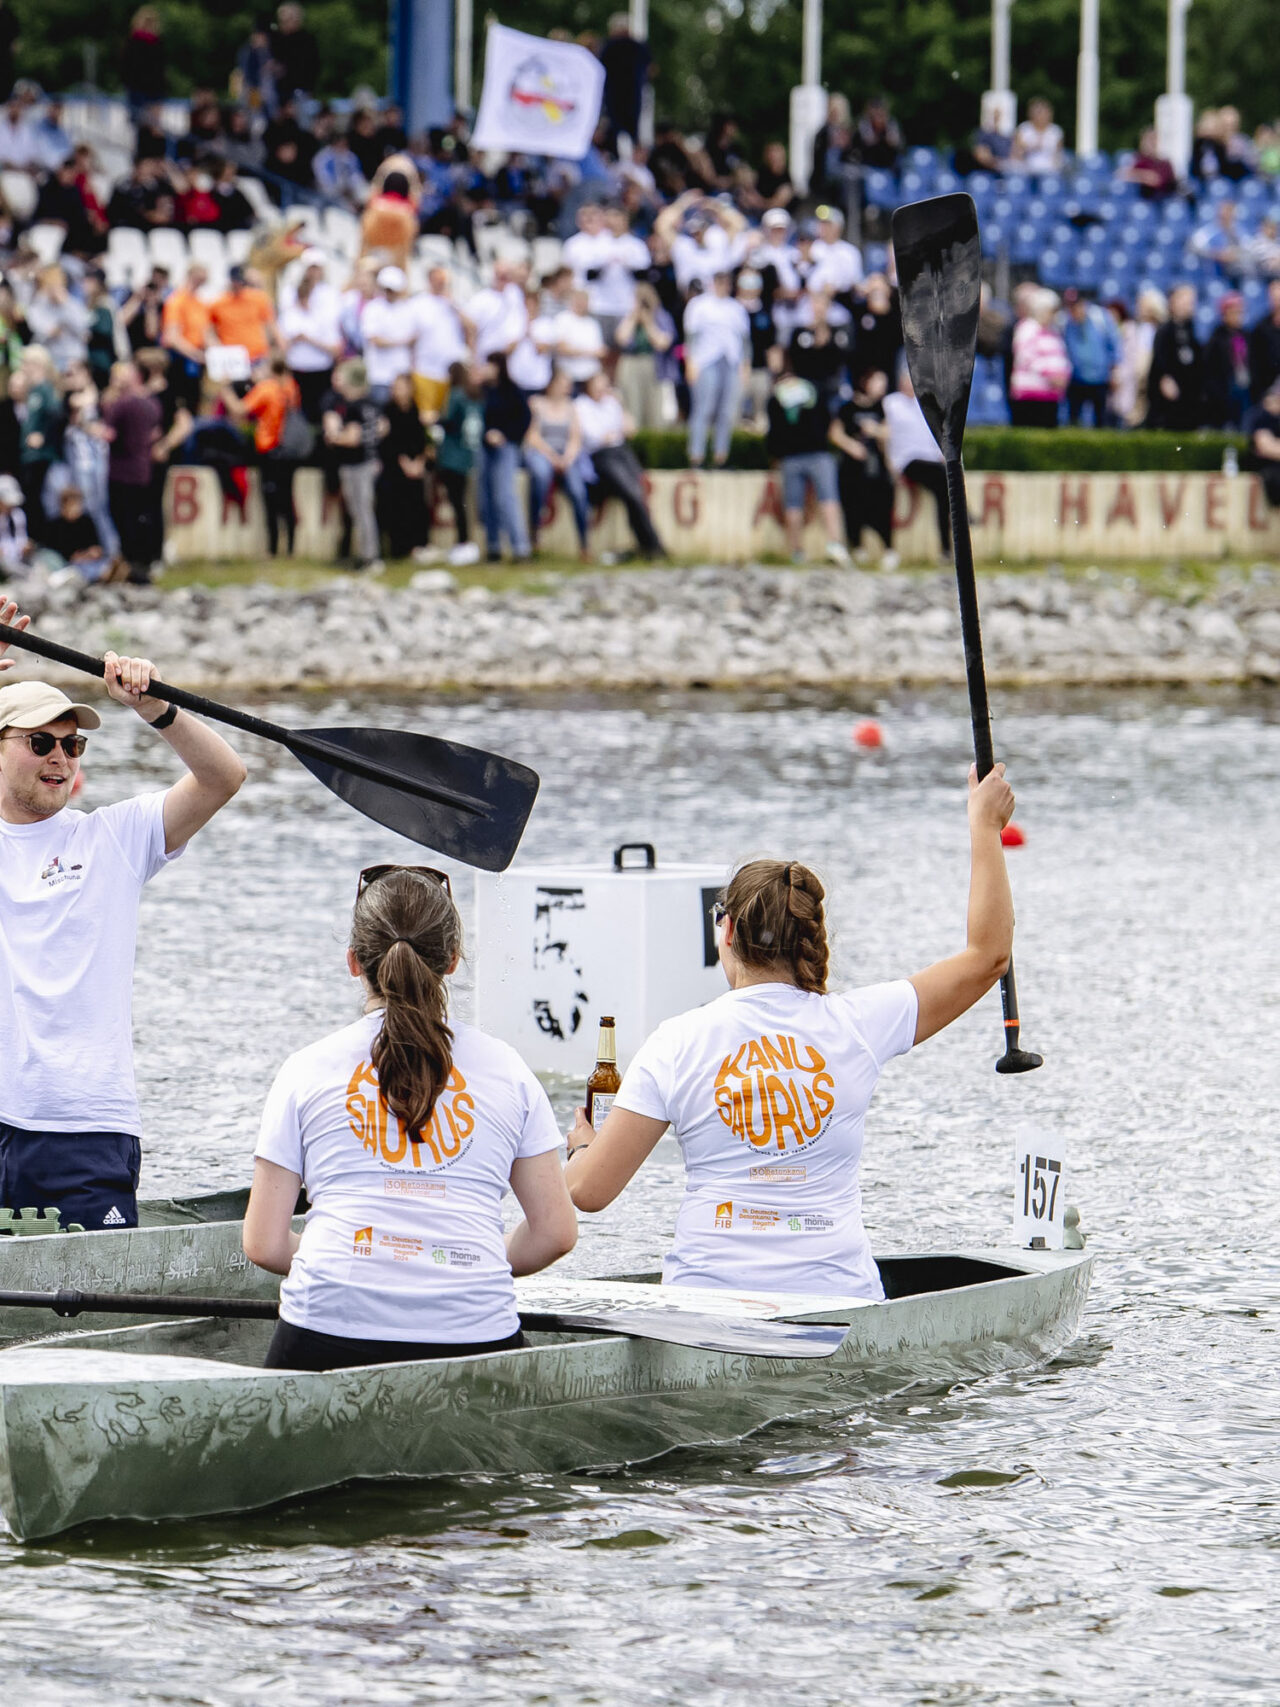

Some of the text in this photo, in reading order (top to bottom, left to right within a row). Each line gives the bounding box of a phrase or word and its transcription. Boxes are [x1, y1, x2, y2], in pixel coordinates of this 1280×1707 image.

[890, 473, 1005, 528] DR
[1059, 472, 1270, 528] HAVEL
[533, 886, 588, 1041] 5
[714, 1034, 826, 1089] KANU
[715, 1067, 835, 1150] SAURUS
[1021, 1154, 1061, 1222] 157
[103, 1217, 127, 1225] adidas
[714, 1220, 732, 1229] FIB
[804, 1217, 834, 1227] thomas
[353, 1246, 372, 1256] FIB
[450, 1251, 481, 1262] thomas
